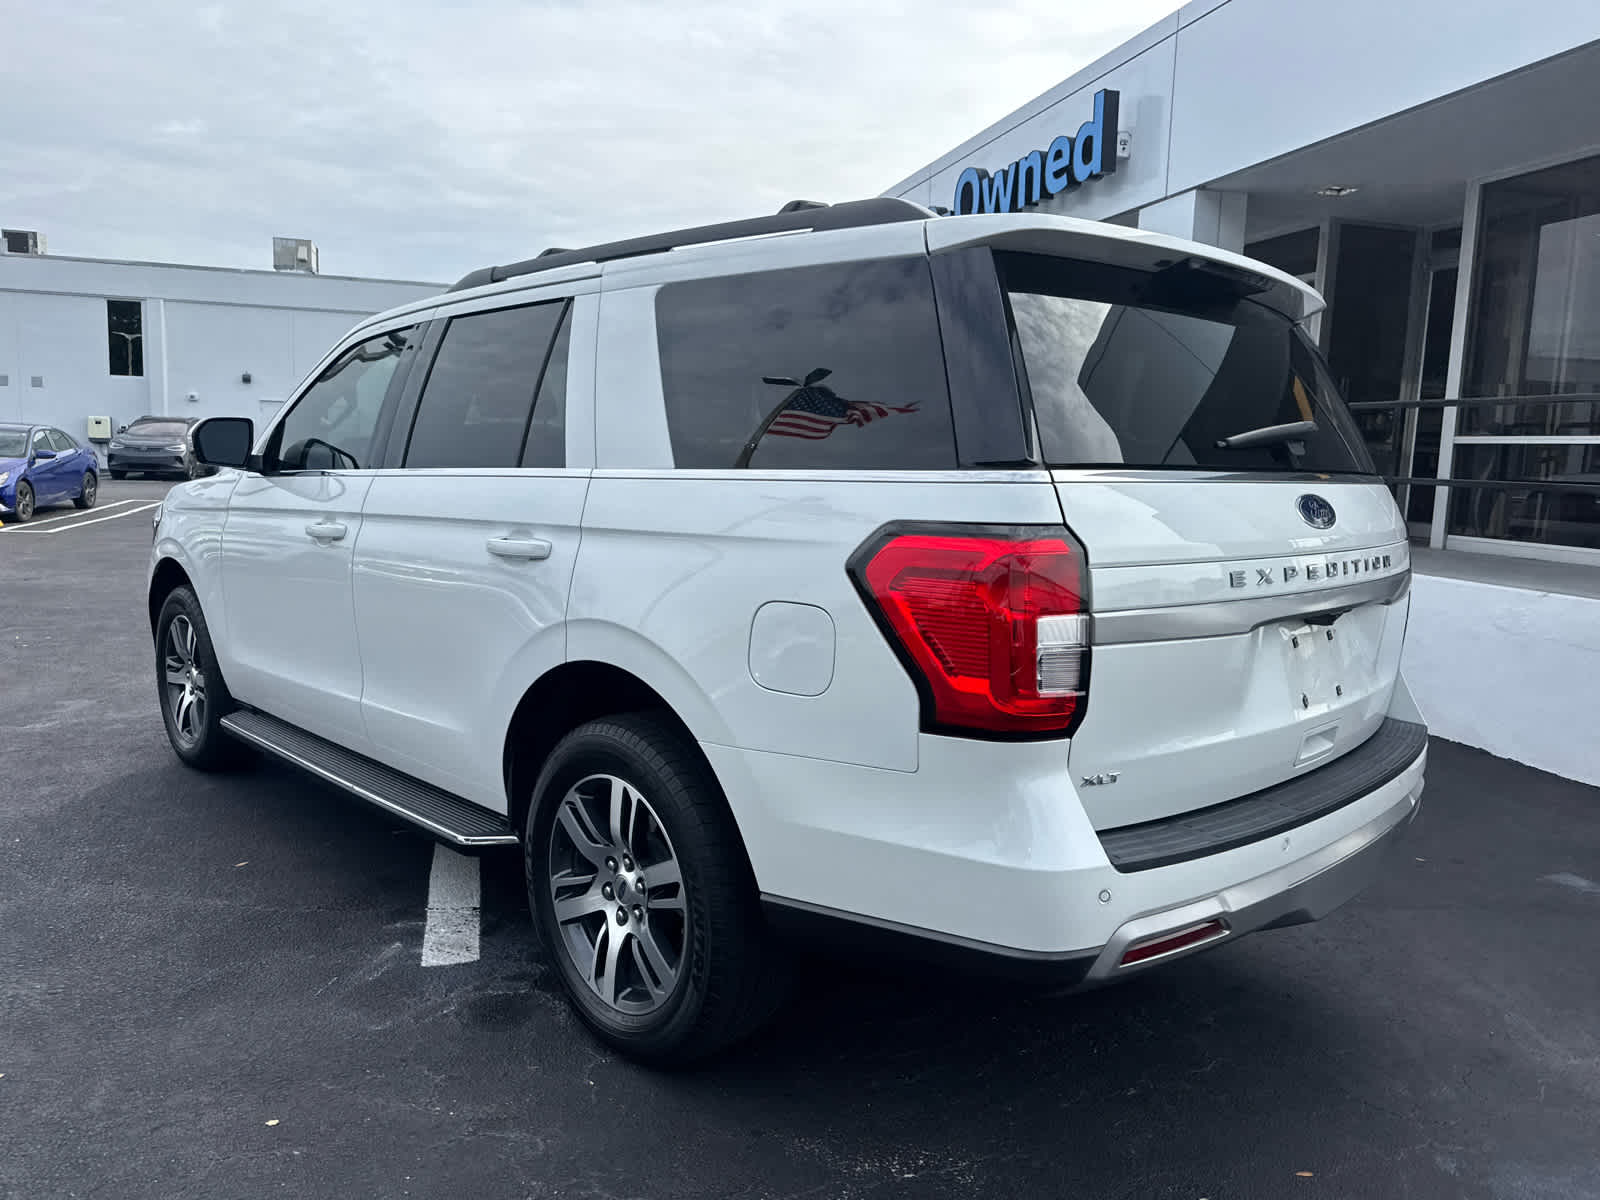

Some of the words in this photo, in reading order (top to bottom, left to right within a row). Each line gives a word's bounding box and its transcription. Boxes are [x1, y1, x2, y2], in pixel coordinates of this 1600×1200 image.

[953, 88, 1119, 215] Owned
[1229, 555, 1392, 588] EXPEDITION
[1080, 772, 1120, 787] XLT
